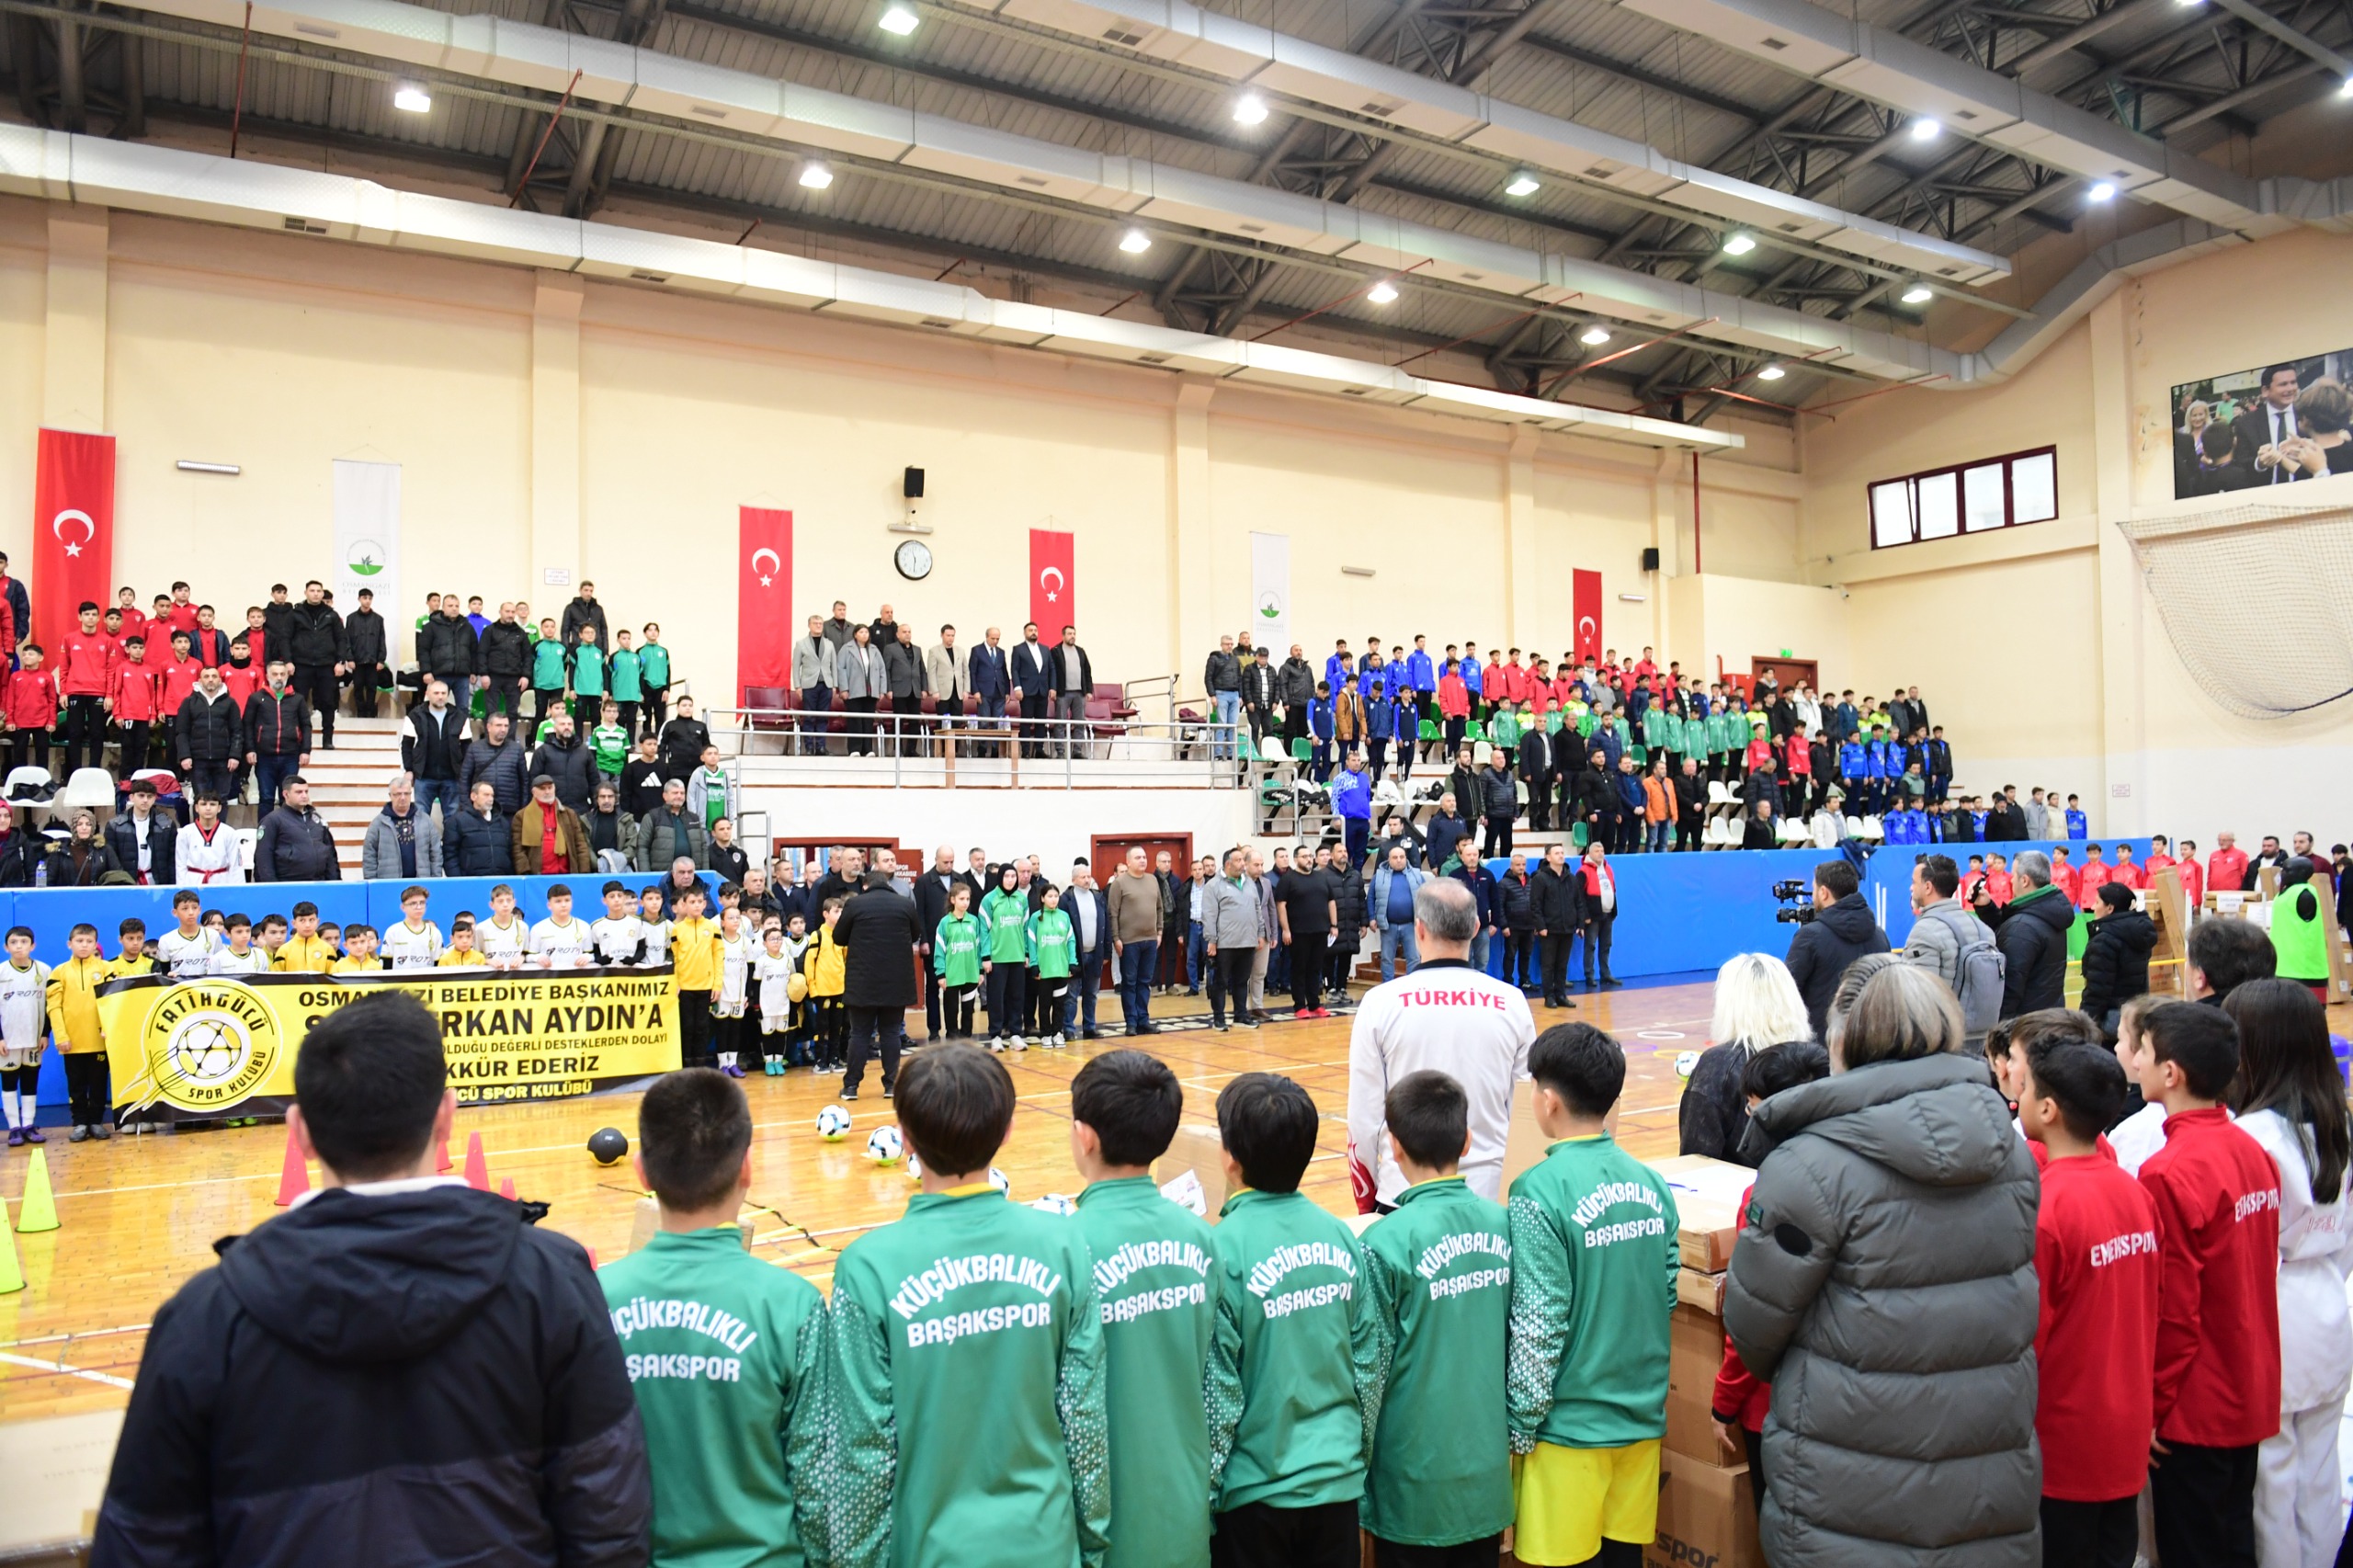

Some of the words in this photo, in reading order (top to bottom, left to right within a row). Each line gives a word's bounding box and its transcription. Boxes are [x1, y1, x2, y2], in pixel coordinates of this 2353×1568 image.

[125, 720, 133, 729] 17
[441, 983, 542, 1003] BELEDİYE
[549, 982, 669, 1003] BAŞKANIMIZ
[732, 1006, 741, 1015] 19
[1398, 988, 1506, 1011] TÜRKİYE
[155, 992, 268, 1033] FATİHGÜCÜ
[437, 1008, 533, 1038] RKAN
[491, 1038, 541, 1051] DEĞERLİ
[545, 1034, 629, 1051] DESTEKLERDEN
[631, 1033, 668, 1045] DOLAYI
[188, 1087, 223, 1099] SPOR
[228, 1051, 267, 1093] KULÜBÜ
[517, 1052, 599, 1076] EDERİZ
[456, 1085, 479, 1101] CÜ
[482, 1085, 528, 1101] SPOR
[531, 1079, 593, 1098] KULÜBÜ
[1571, 1181, 1664, 1229] KÜÇÜKBALIKLI
[1585, 1218, 1665, 1249] BAŞAKSPOR
[1093, 1240, 1212, 1294] ÜÇÜKBALIKLI
[1246, 1242, 1357, 1298] KÜÇÜKBALIKLI
[1415, 1232, 1512, 1279] KÜÇÜKBALIKLI
[889, 1254, 1062, 1320] KÜÇÜKBALIKLI
[1428, 1267, 1510, 1301] BAŞAKSPOR
[1100, 1282, 1206, 1324] BAŞAKSPOR
[608, 1296, 757, 1354] ÇÜKBALIKLI
[906, 1301, 1051, 1347] BAŞAKSPOR
